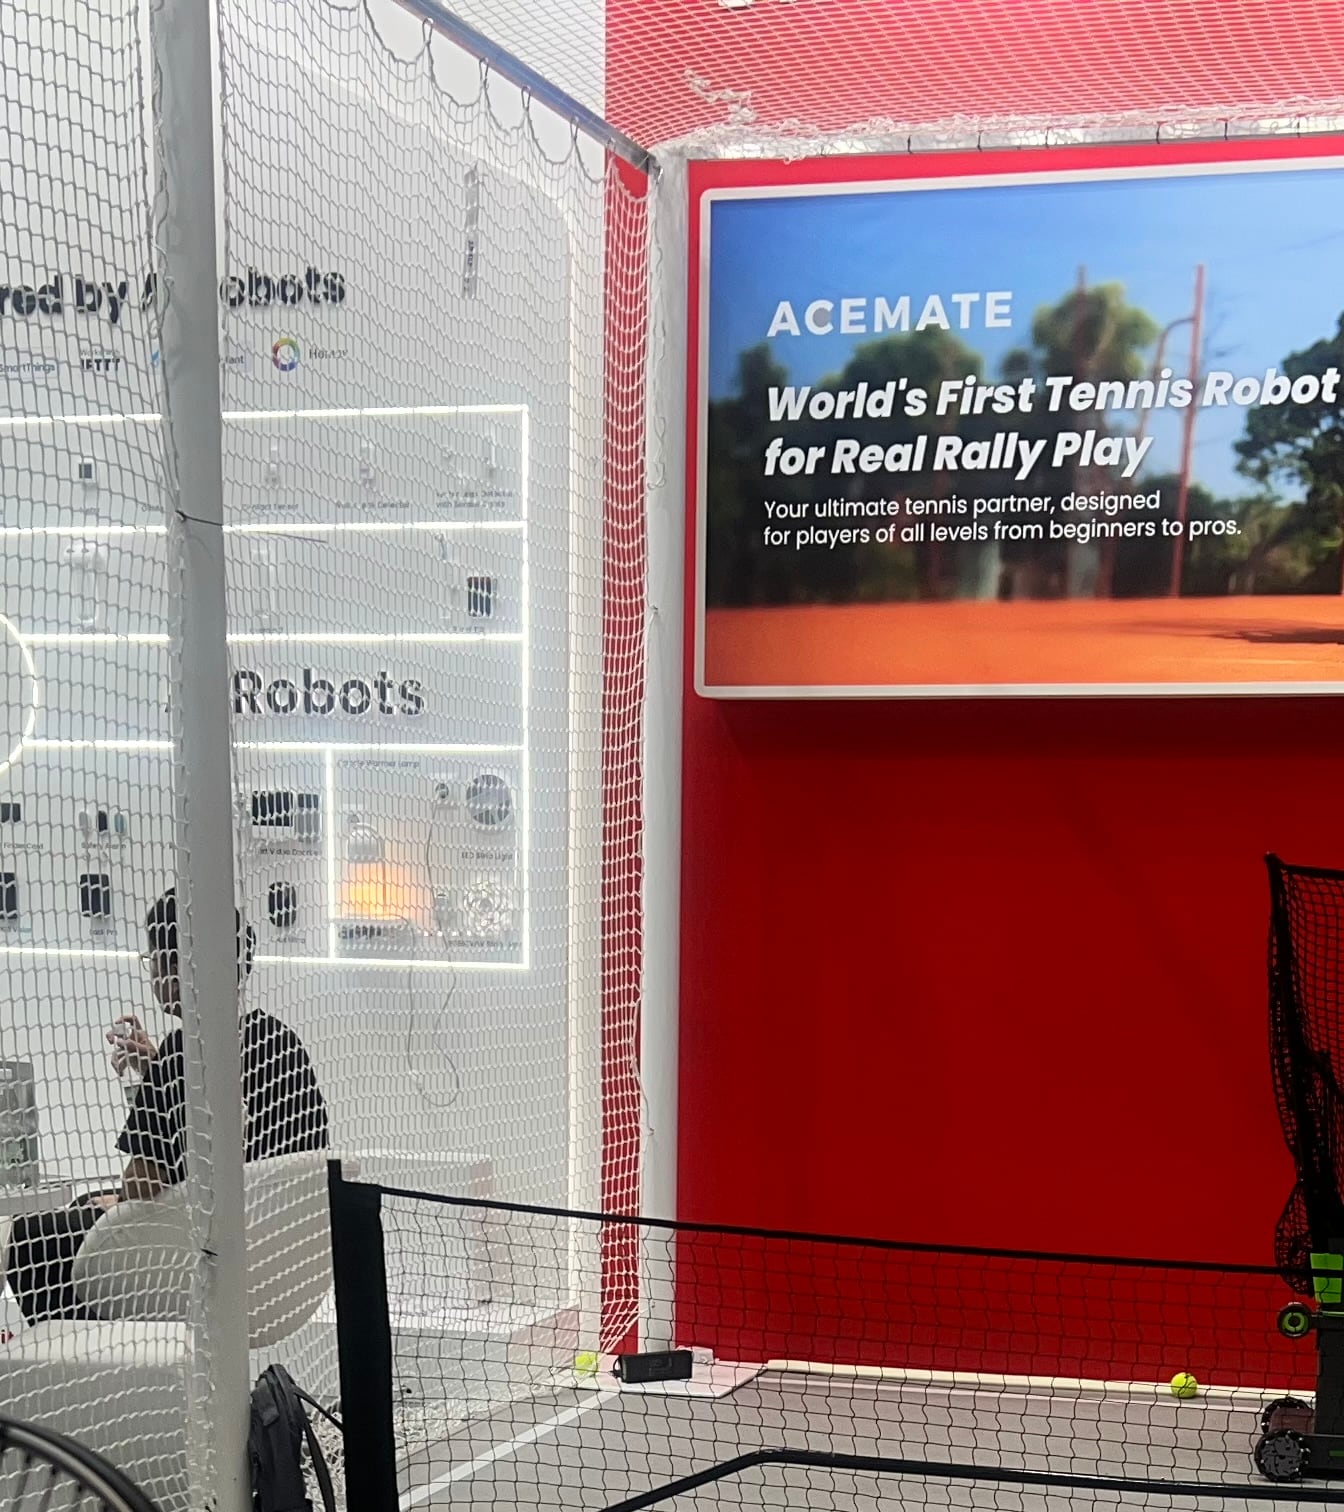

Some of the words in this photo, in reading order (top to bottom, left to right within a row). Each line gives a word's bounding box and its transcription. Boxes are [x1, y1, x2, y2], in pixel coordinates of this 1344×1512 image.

[75, 273, 128, 324] by
[219, 265, 346, 308] obots
[766, 290, 1013, 338] ACEMATE
[767, 377, 928, 421] World's
[935, 375, 1037, 415] First
[1045, 368, 1194, 412] Tennis
[1202, 367, 1342, 407] Robot
[763, 437, 826, 476] for
[830, 434, 928, 474] Real
[933, 431, 1048, 481] Rally
[1051, 430, 1154, 478] Play
[764, 500, 809, 519] Your
[814, 497, 900, 518] ultimate
[905, 495, 968, 516] tennis
[973, 496, 1056, 518] partner,
[1060, 490, 1161, 516] designed
[763, 526, 791, 546] for
[796, 525, 870, 550] players
[875, 524, 897, 543] of
[900, 523, 925, 543] all
[930, 521, 989, 542] levels
[993, 520, 1044, 540] from
[1049, 518, 1156, 544] beginners
[1161, 519, 1184, 538] to
[1188, 519, 1242, 542] pros.
[233, 667, 426, 717] Robots
